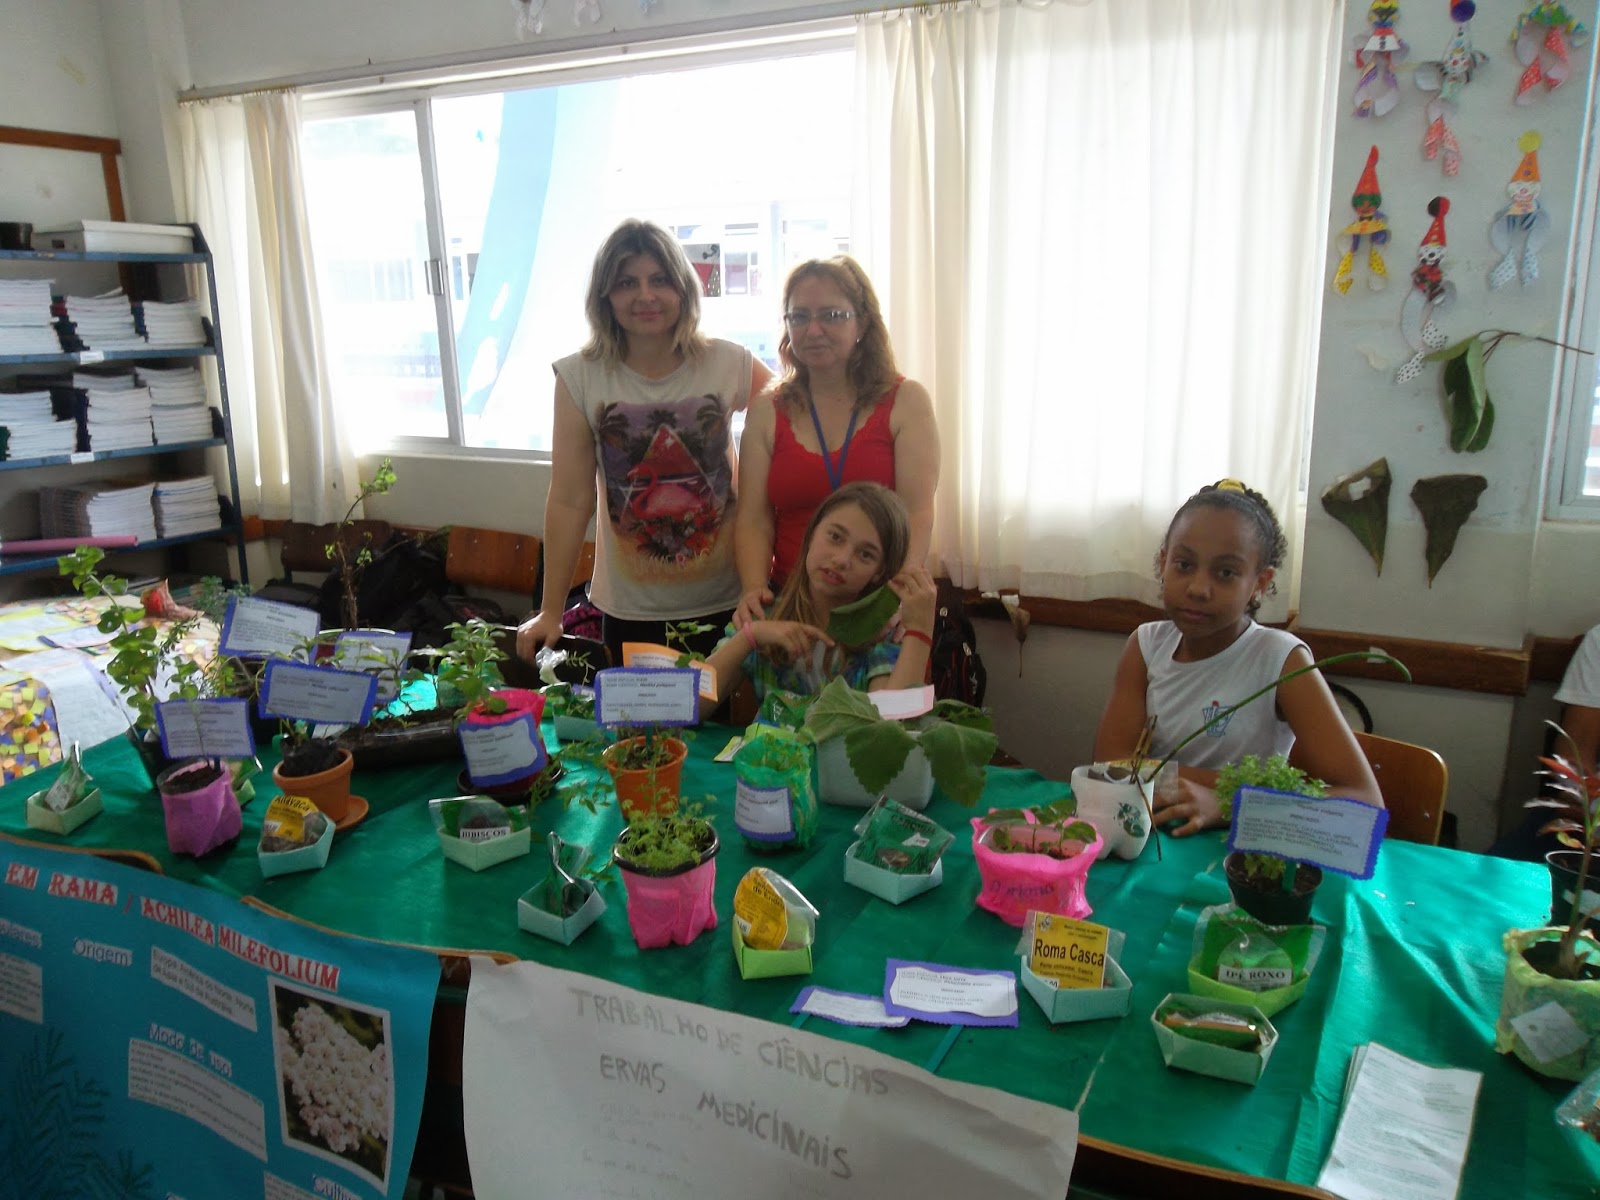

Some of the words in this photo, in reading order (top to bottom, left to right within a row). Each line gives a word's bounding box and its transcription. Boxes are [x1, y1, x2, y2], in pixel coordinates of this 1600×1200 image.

[7, 864, 38, 889] EM
[49, 873, 116, 905] RAMA
[143, 898, 214, 945] ACHILEA
[219, 926, 338, 991] MILEFOLIUM
[75, 938, 132, 965] Origem
[1034, 939, 1066, 959] Roma
[1070, 943, 1104, 967] Casca
[1249, 971, 1285, 979] ROXO
[566, 986, 708, 1042] TRABALHO
[717, 1028, 743, 1055] DE
[150, 1024, 184, 1050] Modo
[600, 1053, 666, 1093] ERVAS
